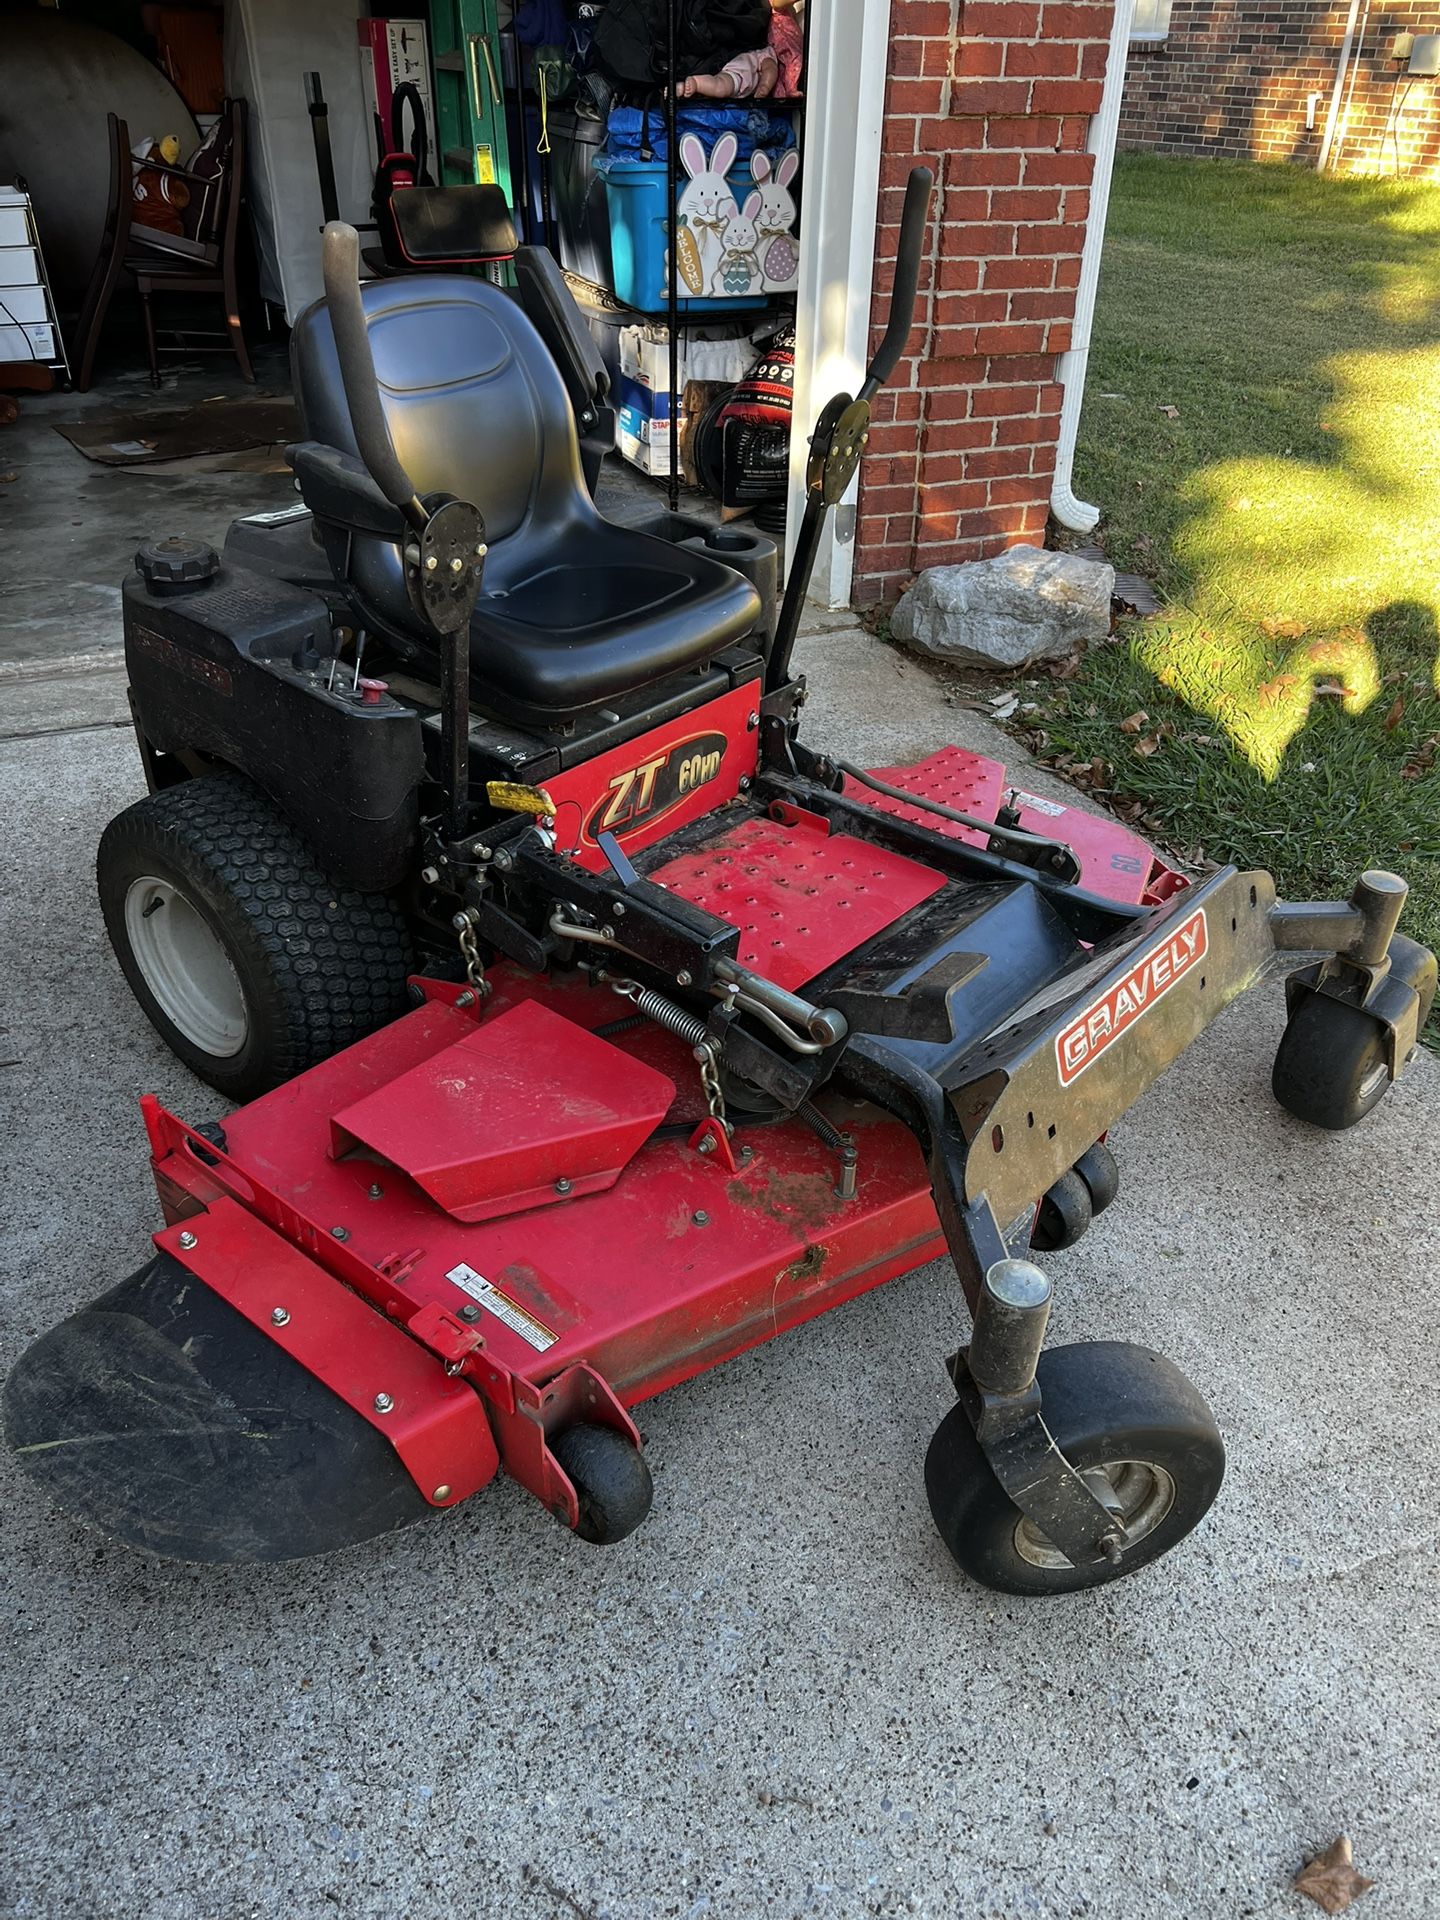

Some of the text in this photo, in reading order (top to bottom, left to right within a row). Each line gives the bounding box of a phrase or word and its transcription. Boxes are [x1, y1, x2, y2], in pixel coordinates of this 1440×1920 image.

[389, 28, 396, 37] UP
[391, 51, 399, 66] EASY
[676, 229, 702, 289] WELCOME
[603, 750, 720, 827] ZT 60HD
[1110, 854, 1142, 874] 60
[1063, 919, 1201, 1072] GRAVELY
